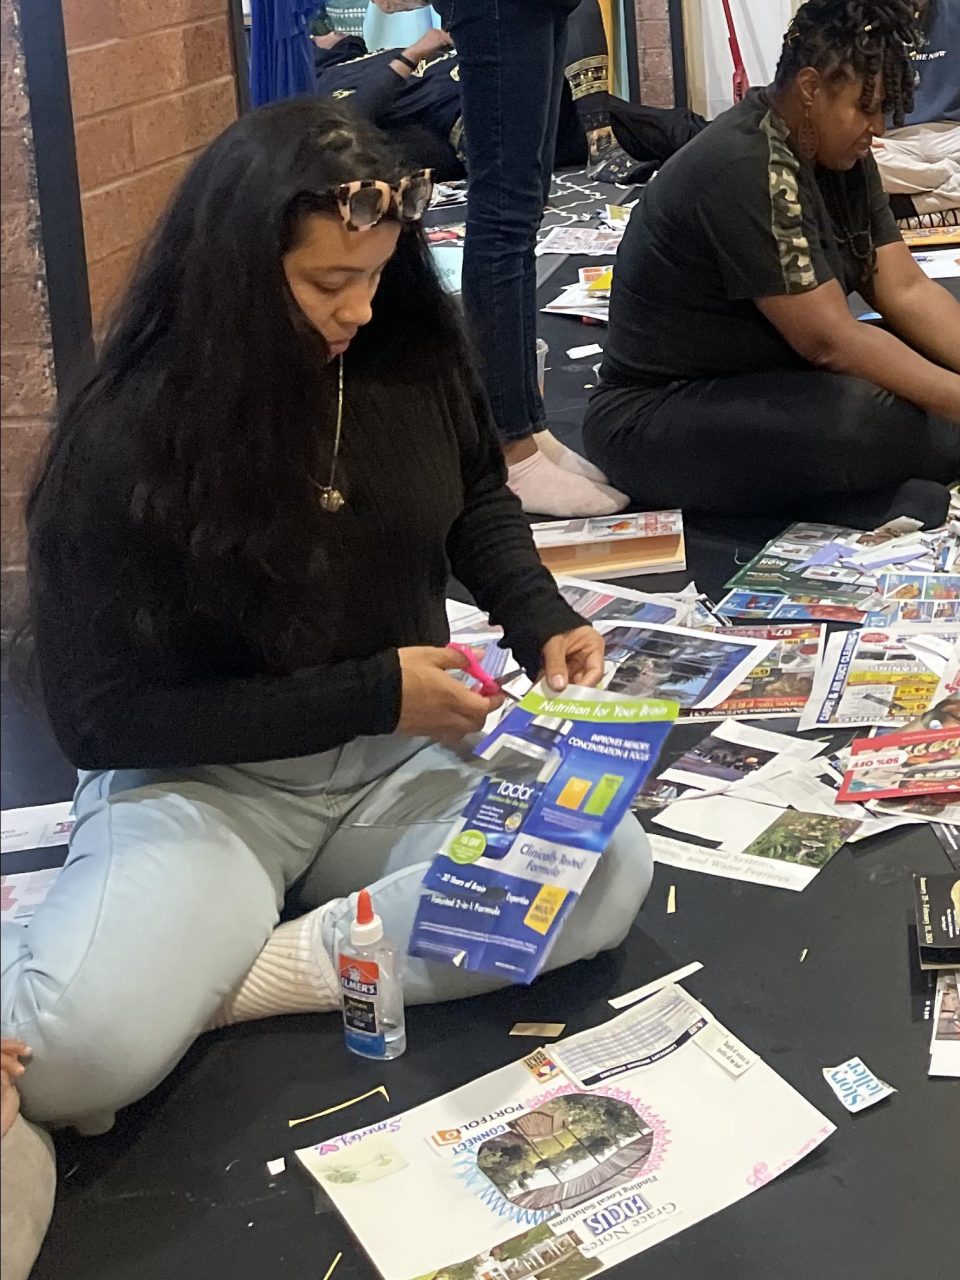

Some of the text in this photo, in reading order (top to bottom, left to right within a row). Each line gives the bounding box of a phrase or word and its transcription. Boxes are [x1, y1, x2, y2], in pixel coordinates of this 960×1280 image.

[538, 701, 590, 715] Nutrition
[593, 704, 609, 717] for
[878, 756, 900, 766] 50%
[520, 843, 558, 865] Clinically
[341, 977, 376, 994] ELMER'S
[831, 1071, 866, 1106] Story
[452, 1125, 506, 1156] CONNECT
[551, 1175, 658, 1228] Finding Local Solutions
[586, 1194, 648, 1234] FOCUS
[582, 1202, 677, 1253] Grace Notes
